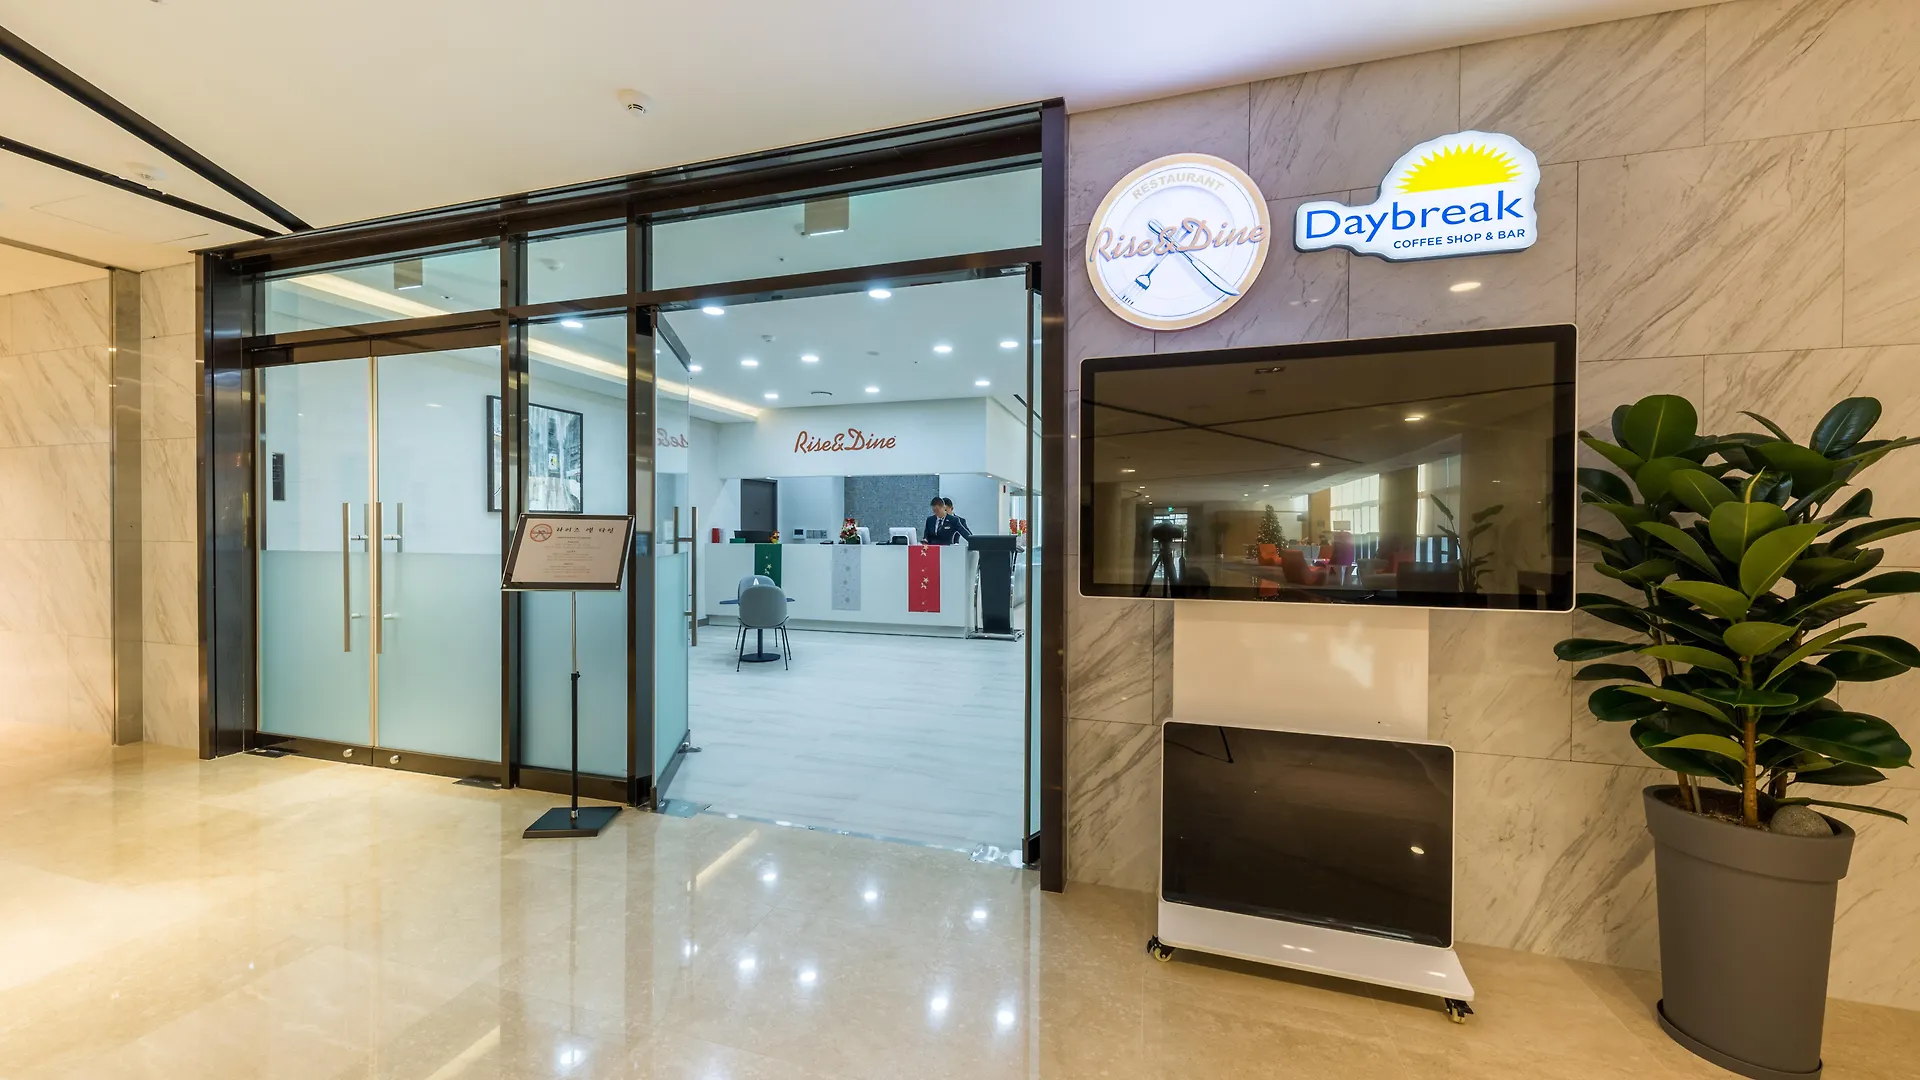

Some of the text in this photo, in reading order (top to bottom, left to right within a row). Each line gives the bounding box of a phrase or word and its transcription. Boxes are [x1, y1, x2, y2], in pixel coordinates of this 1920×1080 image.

[1132, 172, 1225, 200] RESTAURANT
[1306, 190, 1524, 242] Daybreak
[1089, 217, 1268, 262] Rise&Dine
[1393, 229, 1525, 249] COFFEE SHOP & BAR
[794, 428, 897, 454] Rise&Dine
